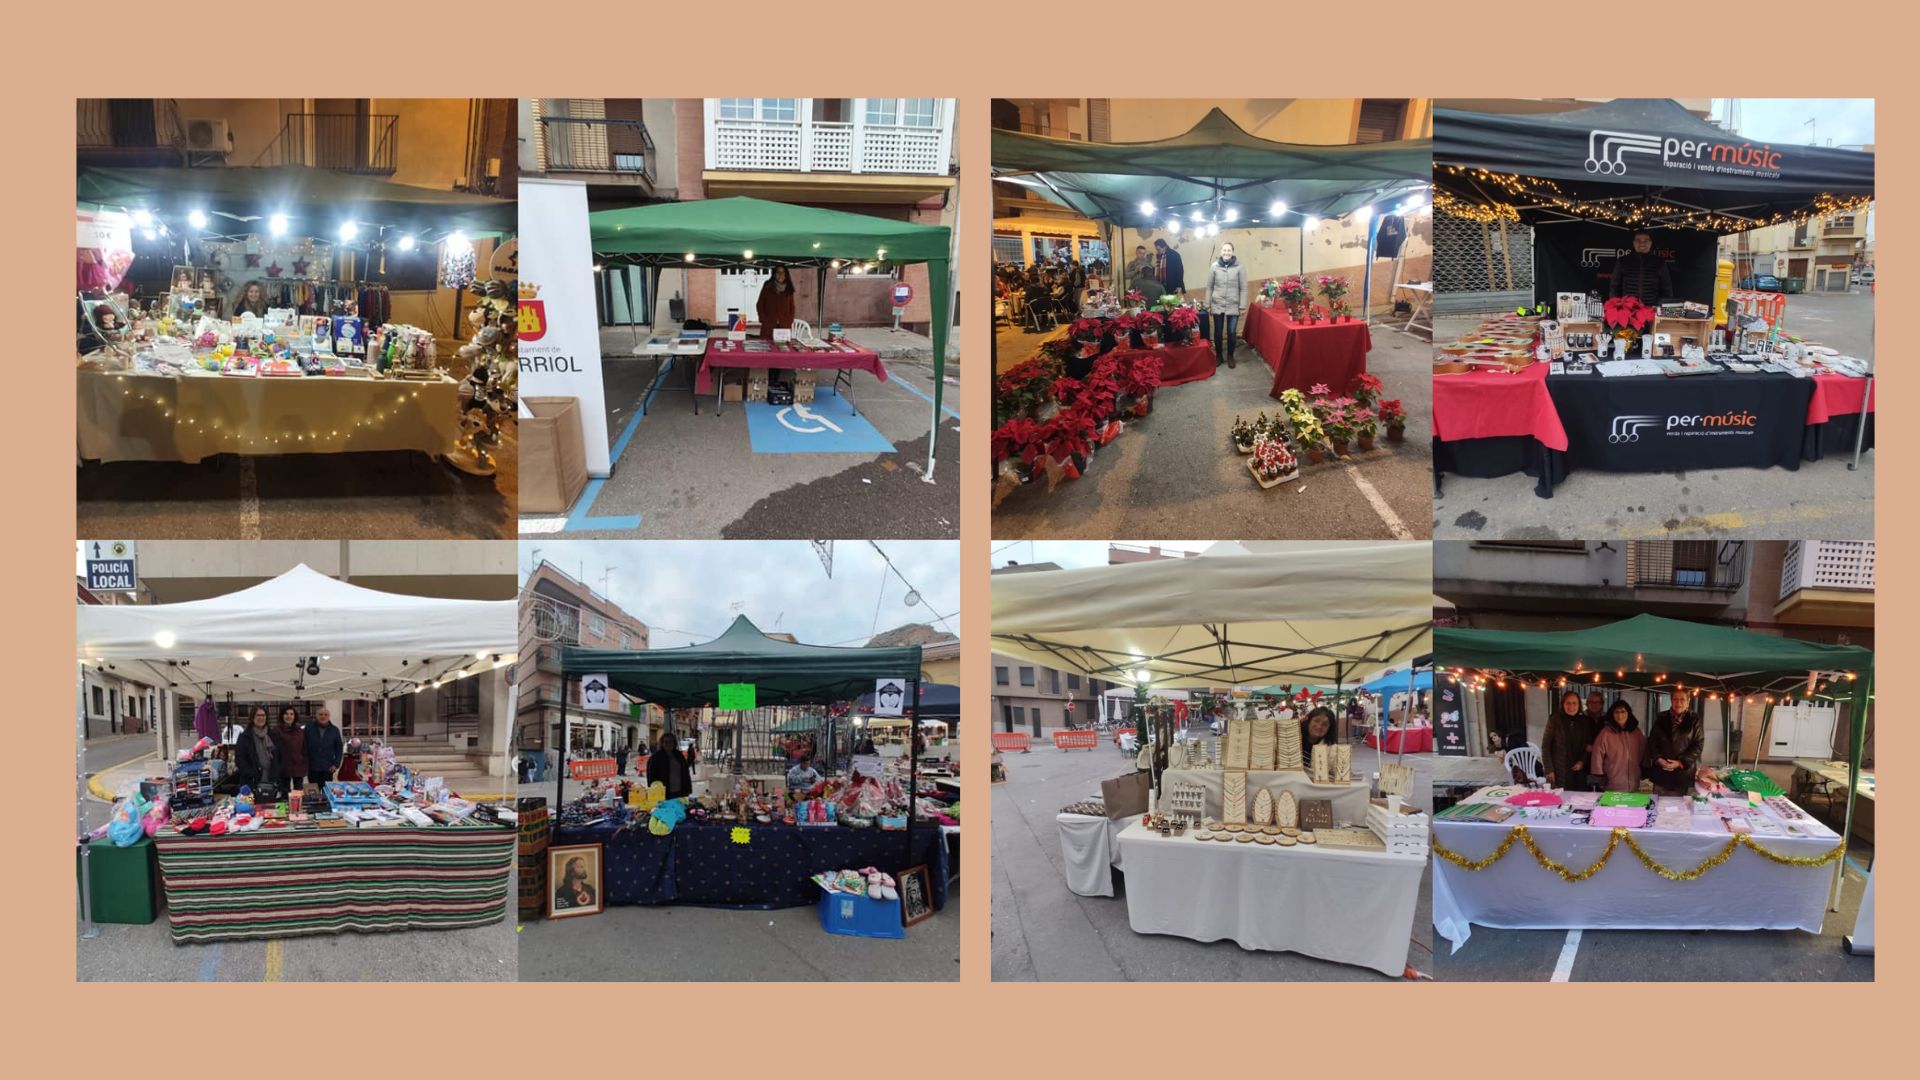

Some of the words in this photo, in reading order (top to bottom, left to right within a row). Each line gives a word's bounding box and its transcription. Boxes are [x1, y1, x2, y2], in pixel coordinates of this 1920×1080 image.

[518, 356, 583, 373] RRIOL
[92, 561, 129, 574] POLICÍA
[92, 575, 132, 588] LOCAL
